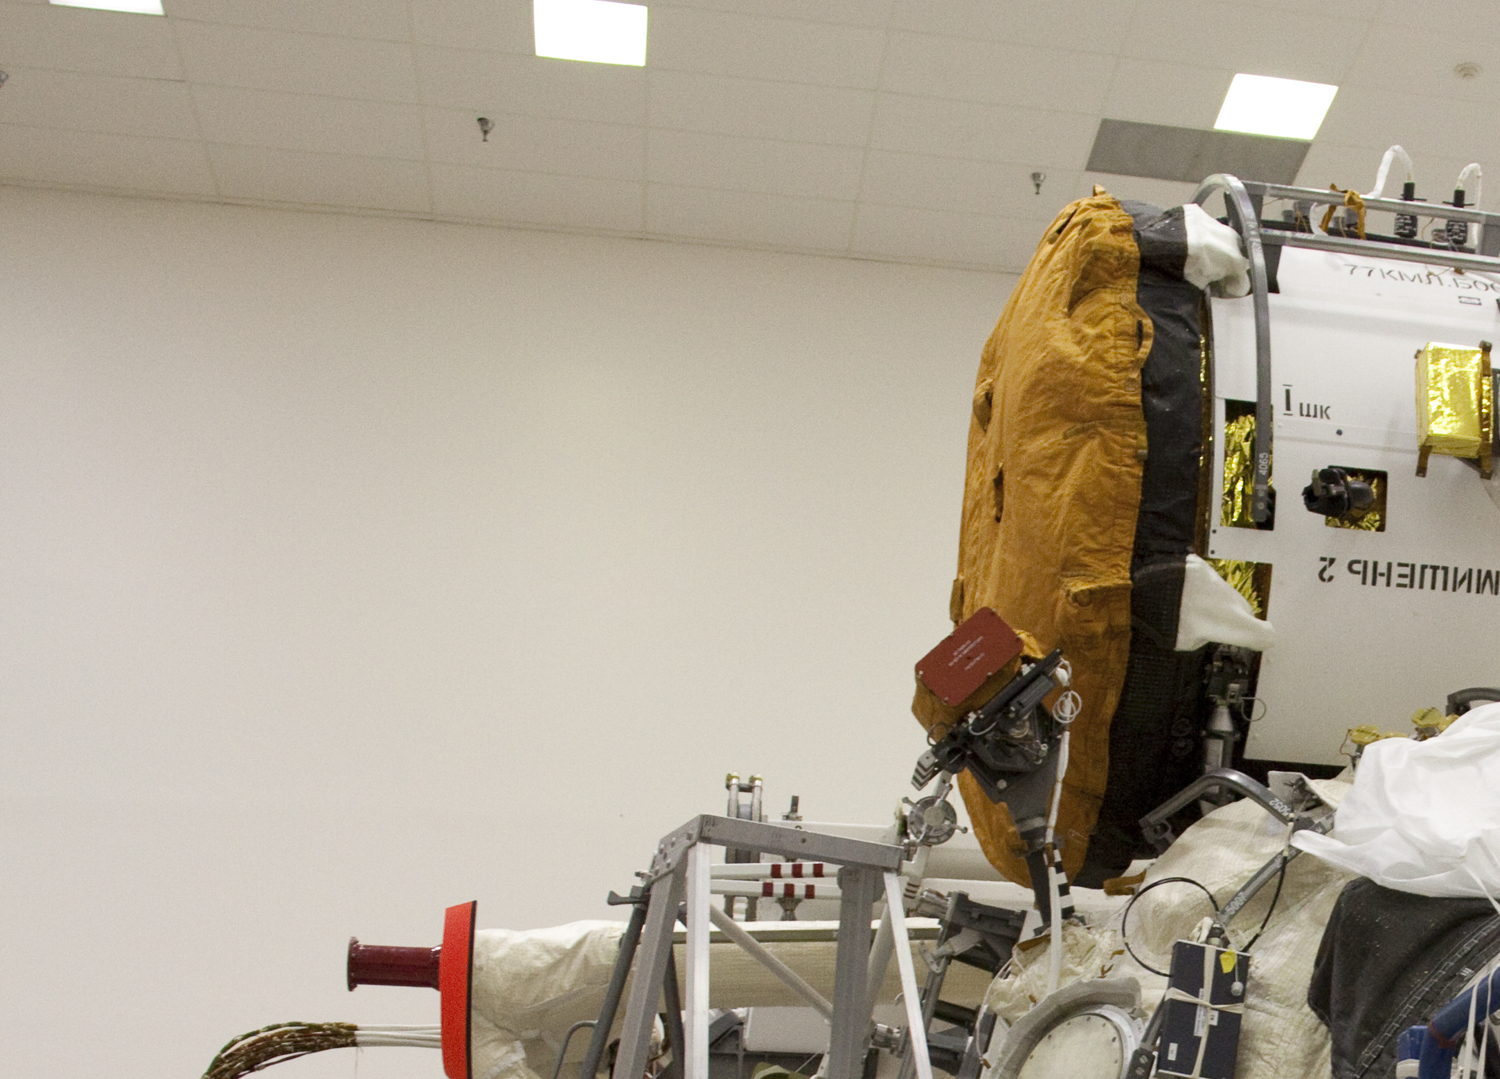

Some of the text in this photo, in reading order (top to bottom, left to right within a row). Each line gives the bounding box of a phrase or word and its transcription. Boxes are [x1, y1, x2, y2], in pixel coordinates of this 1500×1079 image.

[1258, 452, 1269, 476] 4065
[1318, 556, 1500, 596] МИШЕНЬ 2
